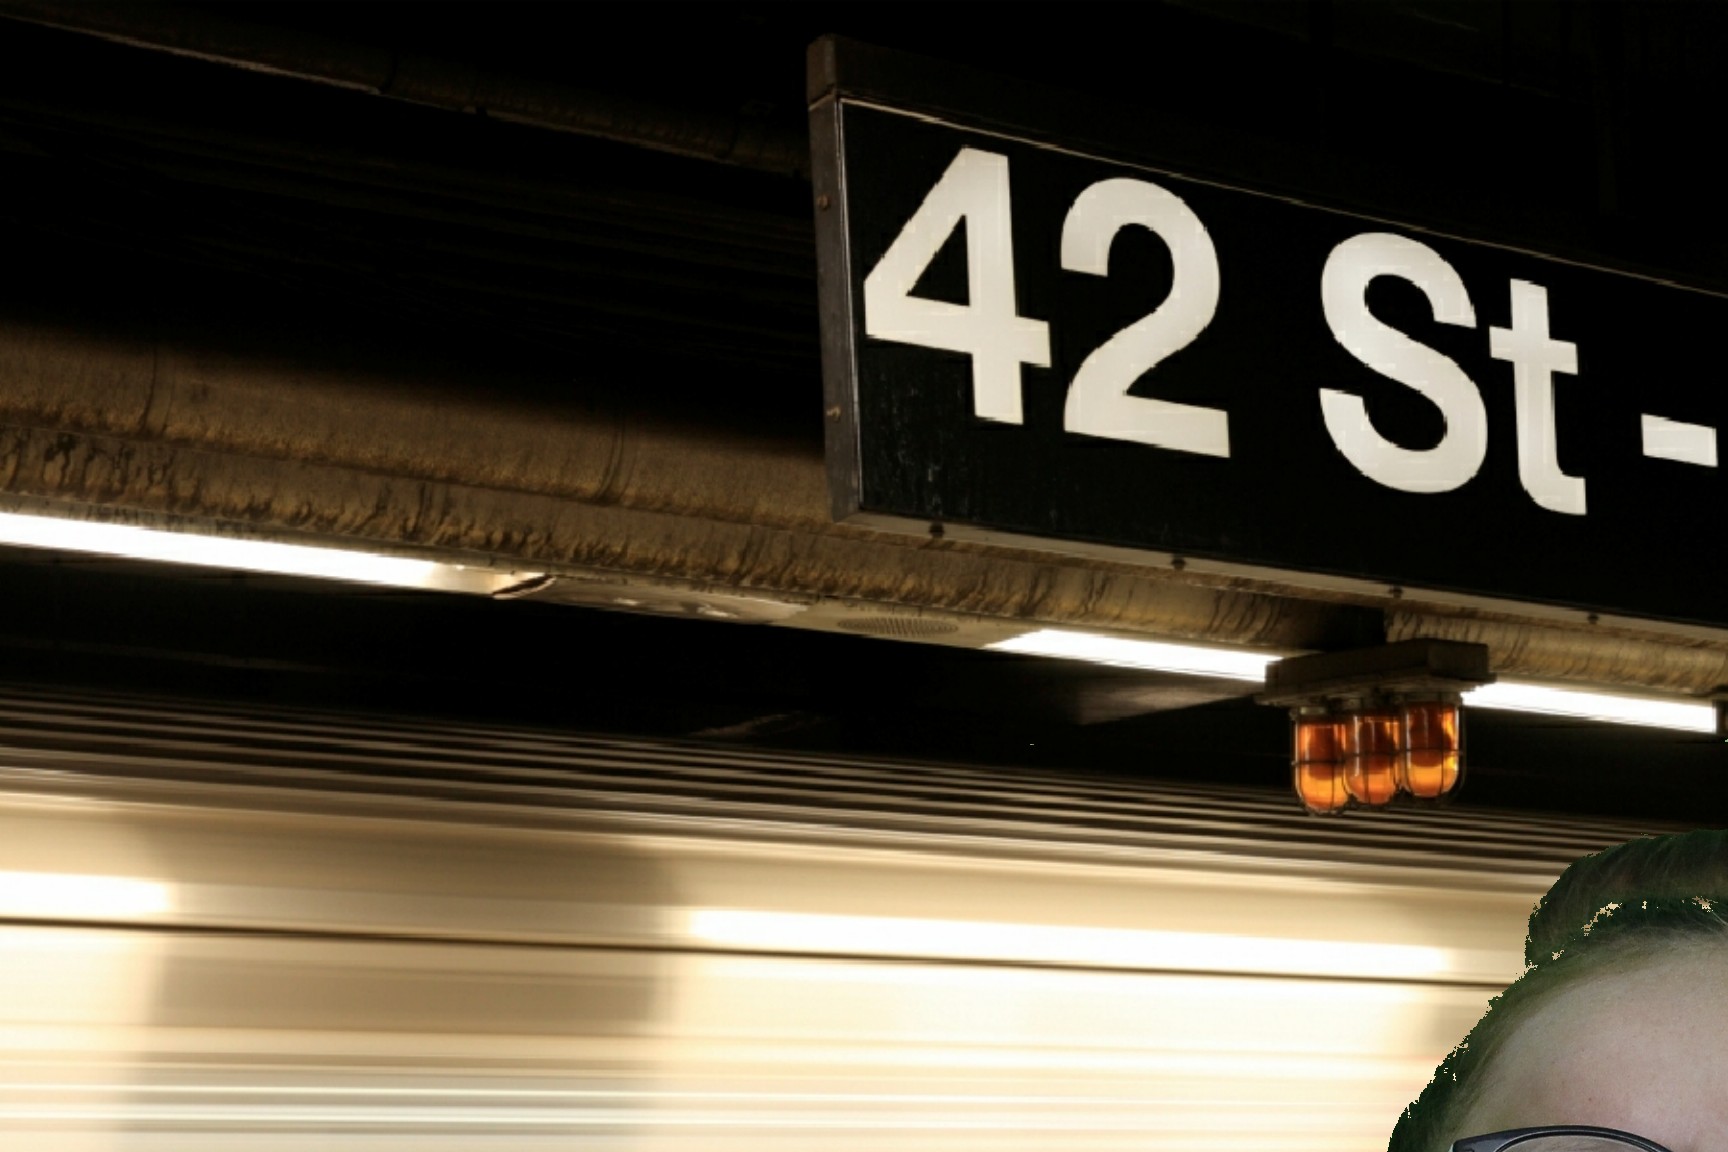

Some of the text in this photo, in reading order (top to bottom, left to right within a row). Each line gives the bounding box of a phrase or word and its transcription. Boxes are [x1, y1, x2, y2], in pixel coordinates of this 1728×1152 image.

[864, 149, 1230, 458] 42
[1320, 233, 1587, 515] St
[1642, 415, 1718, 467] -
